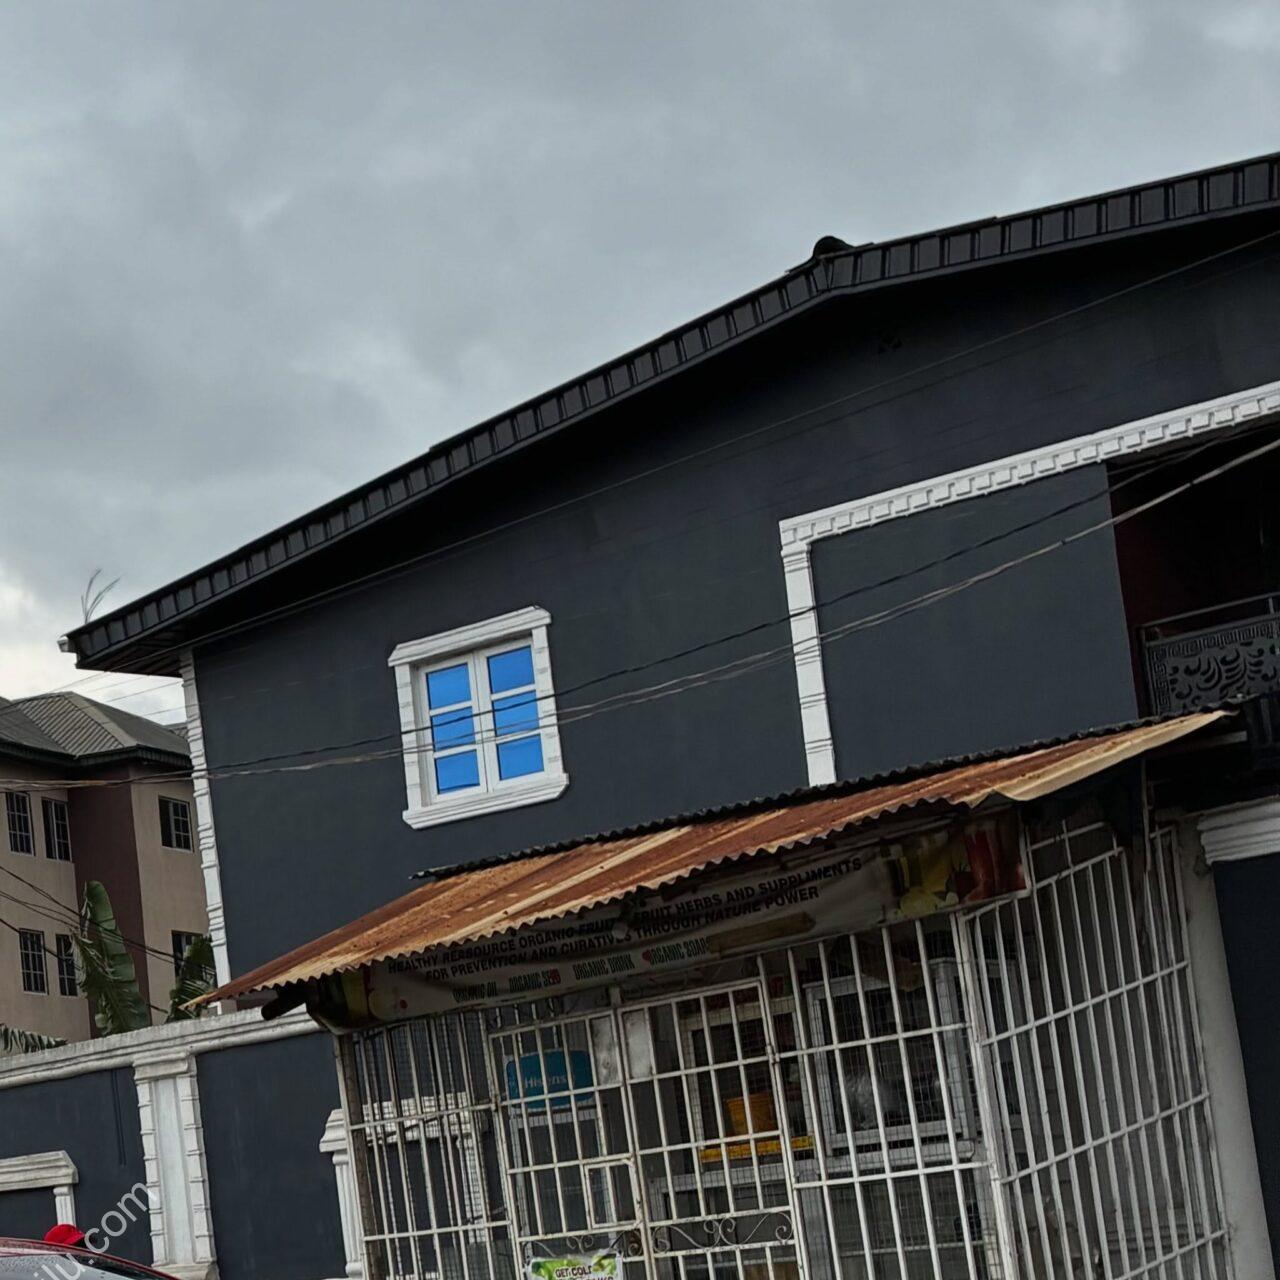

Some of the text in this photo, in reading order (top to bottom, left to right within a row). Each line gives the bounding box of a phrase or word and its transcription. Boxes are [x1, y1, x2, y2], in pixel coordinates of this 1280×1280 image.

[388, 955, 438, 974] HEALTHY
[518, 926, 574, 949] ORGANIC
[675, 894, 722, 915] HERBS
[726, 886, 755, 903] AND
[426, 886, 820, 982] FOR PREVENTION AND CURATIVS THROUGH NATURE POWER
[508, 970, 542, 994] ORGANIC
[573, 960, 609, 981] ORGANIC
[610, 953, 636, 974] DRINK
[555, 1267, 570, 1279] GET
